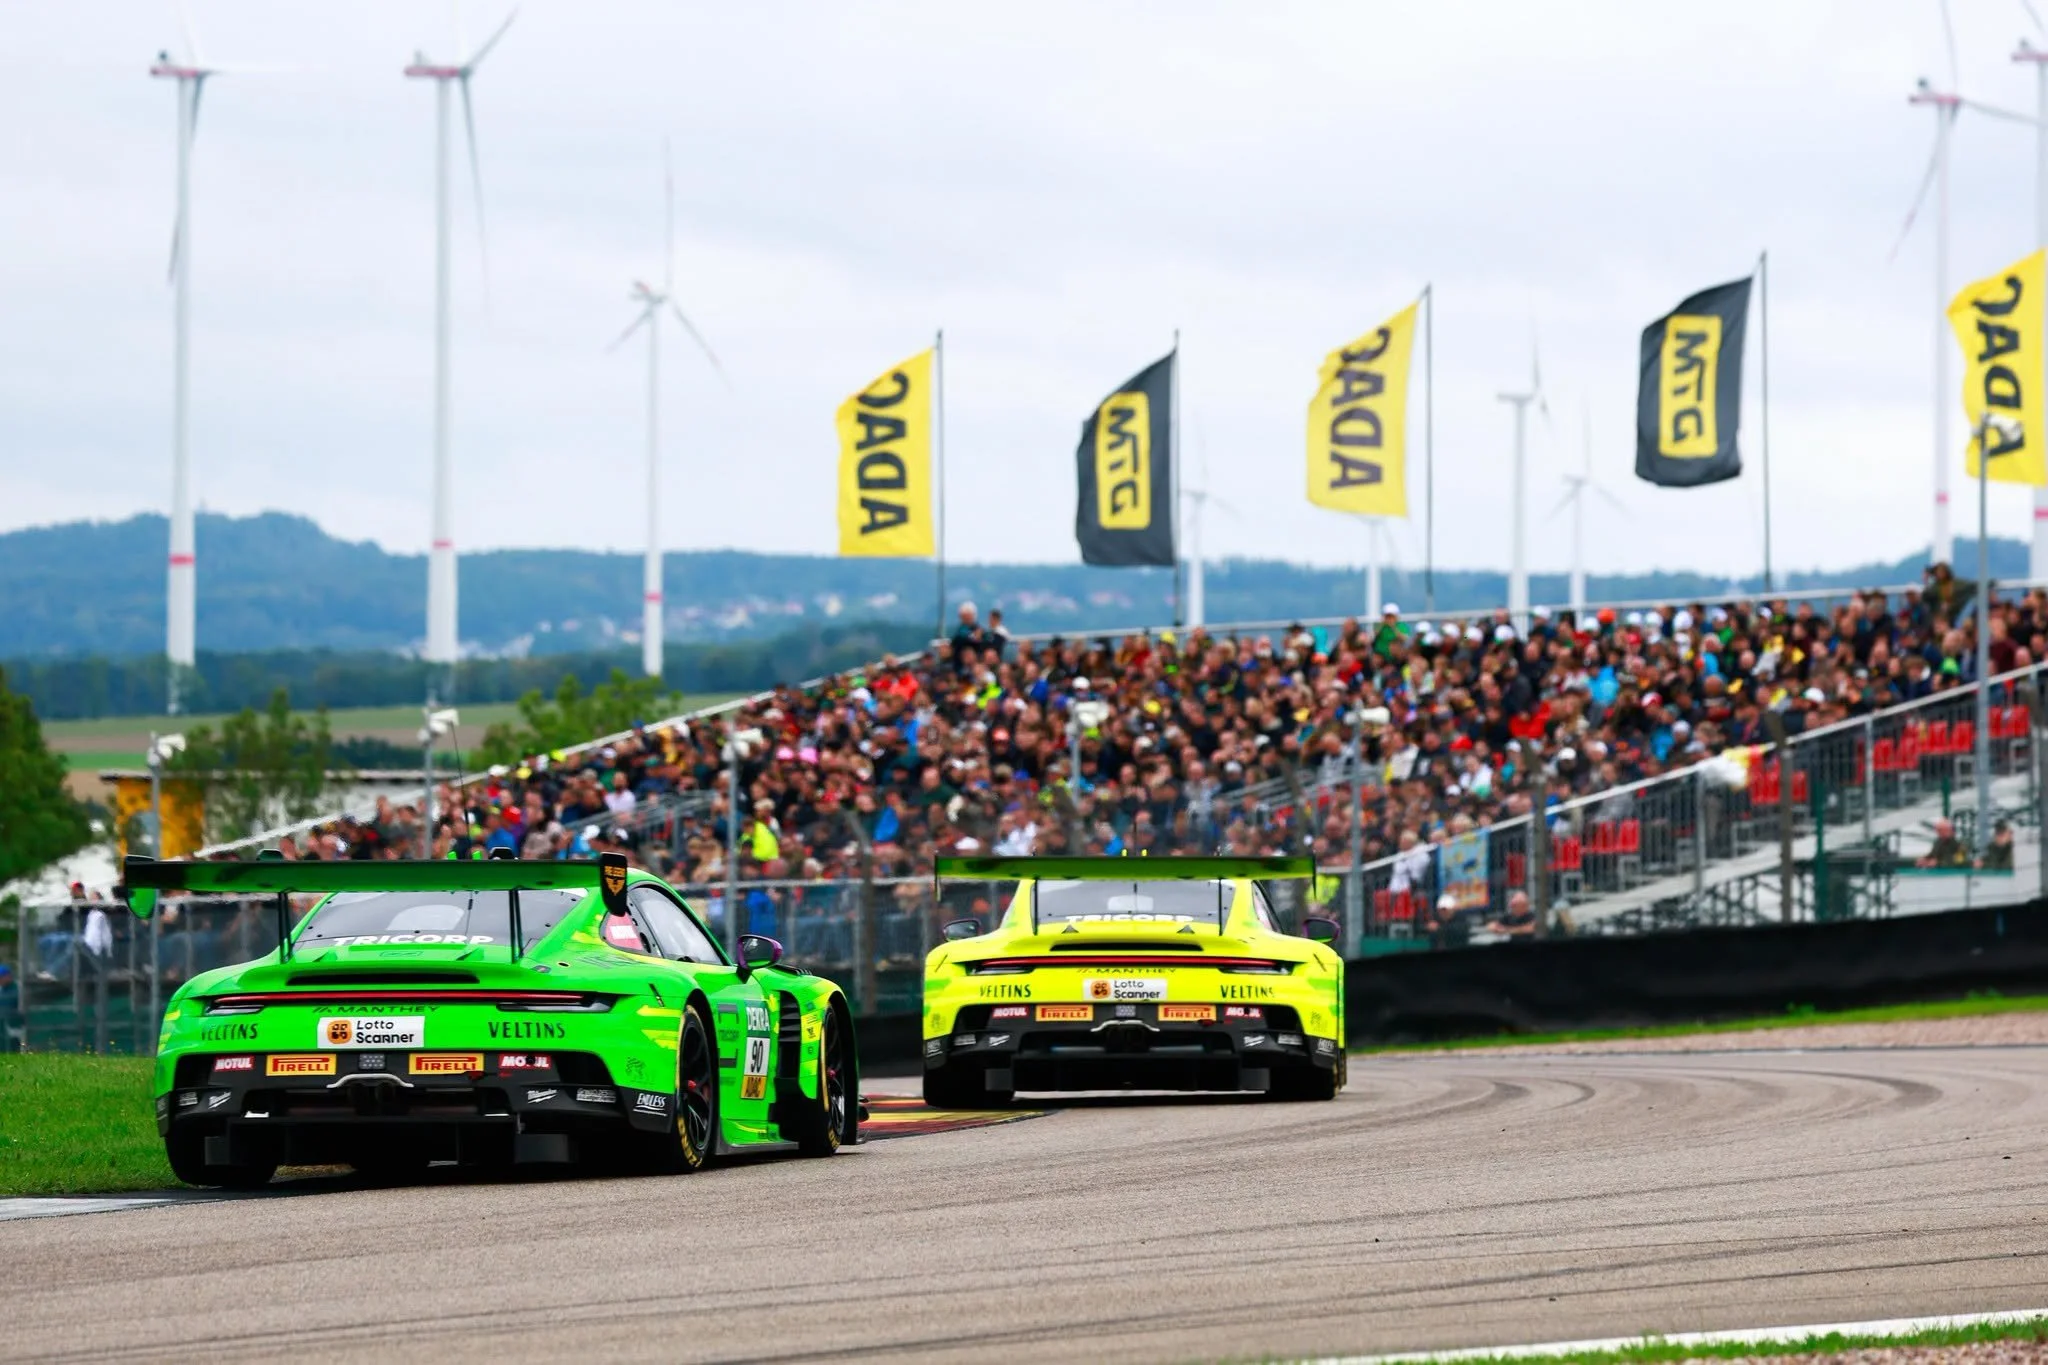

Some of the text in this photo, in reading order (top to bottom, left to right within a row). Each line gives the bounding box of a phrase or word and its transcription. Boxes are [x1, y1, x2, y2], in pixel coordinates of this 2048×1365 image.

[1673, 331, 1709, 444] MTG
[1108, 407, 1139, 516] MTG
[333, 934, 494, 947] TRICORP
[1114, 980, 1144, 988] Lotto
[980, 984, 1032, 998] VELTINS
[1114, 989, 1160, 999] Scanner
[1220, 985, 1275, 998] VELTINS
[992, 1007, 1028, 1017] MOTUL
[1041, 1007, 1088, 1018] PIRELLI
[1164, 1007, 1211, 1018] PIRELLI
[1225, 1006, 1261, 1018] MOUL
[356, 1020, 394, 1030] Lotto
[488, 1022, 566, 1039] VELTINS
[201, 1023, 259, 1041] VELTINS
[356, 1032, 414, 1044] Scanner
[501, 1056, 549, 1067] MOUL
[751, 1040, 764, 1073] 90
[215, 1057, 252, 1070] MOTUL
[272, 1057, 330, 1072] PIRELLI
[416, 1056, 477, 1071] PIRELLI
[636, 1092, 667, 1108] ENDLESS
